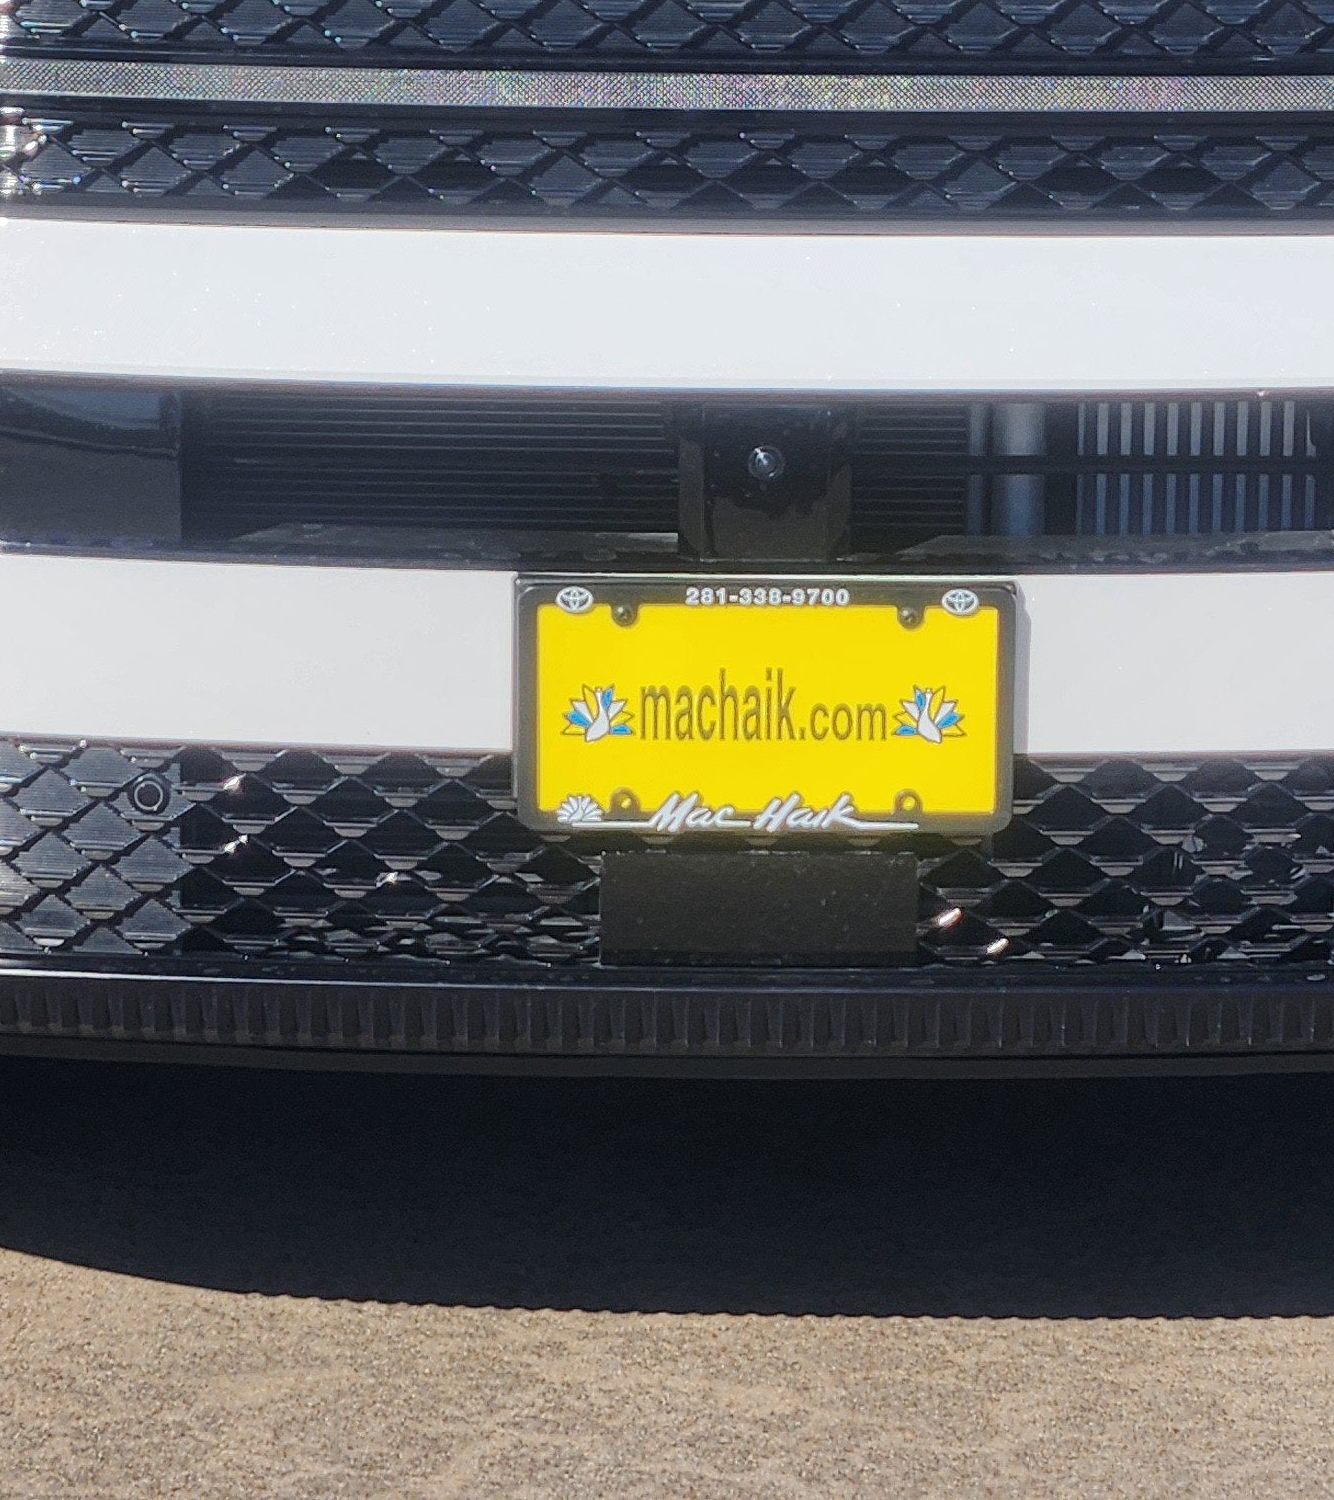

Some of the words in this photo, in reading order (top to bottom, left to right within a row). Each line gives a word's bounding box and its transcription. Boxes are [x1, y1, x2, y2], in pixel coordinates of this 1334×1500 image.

[685, 587, 850, 606] 281-338-9700
[640, 667, 887, 741] machaik.com
[643, 791, 752, 832] Mac
